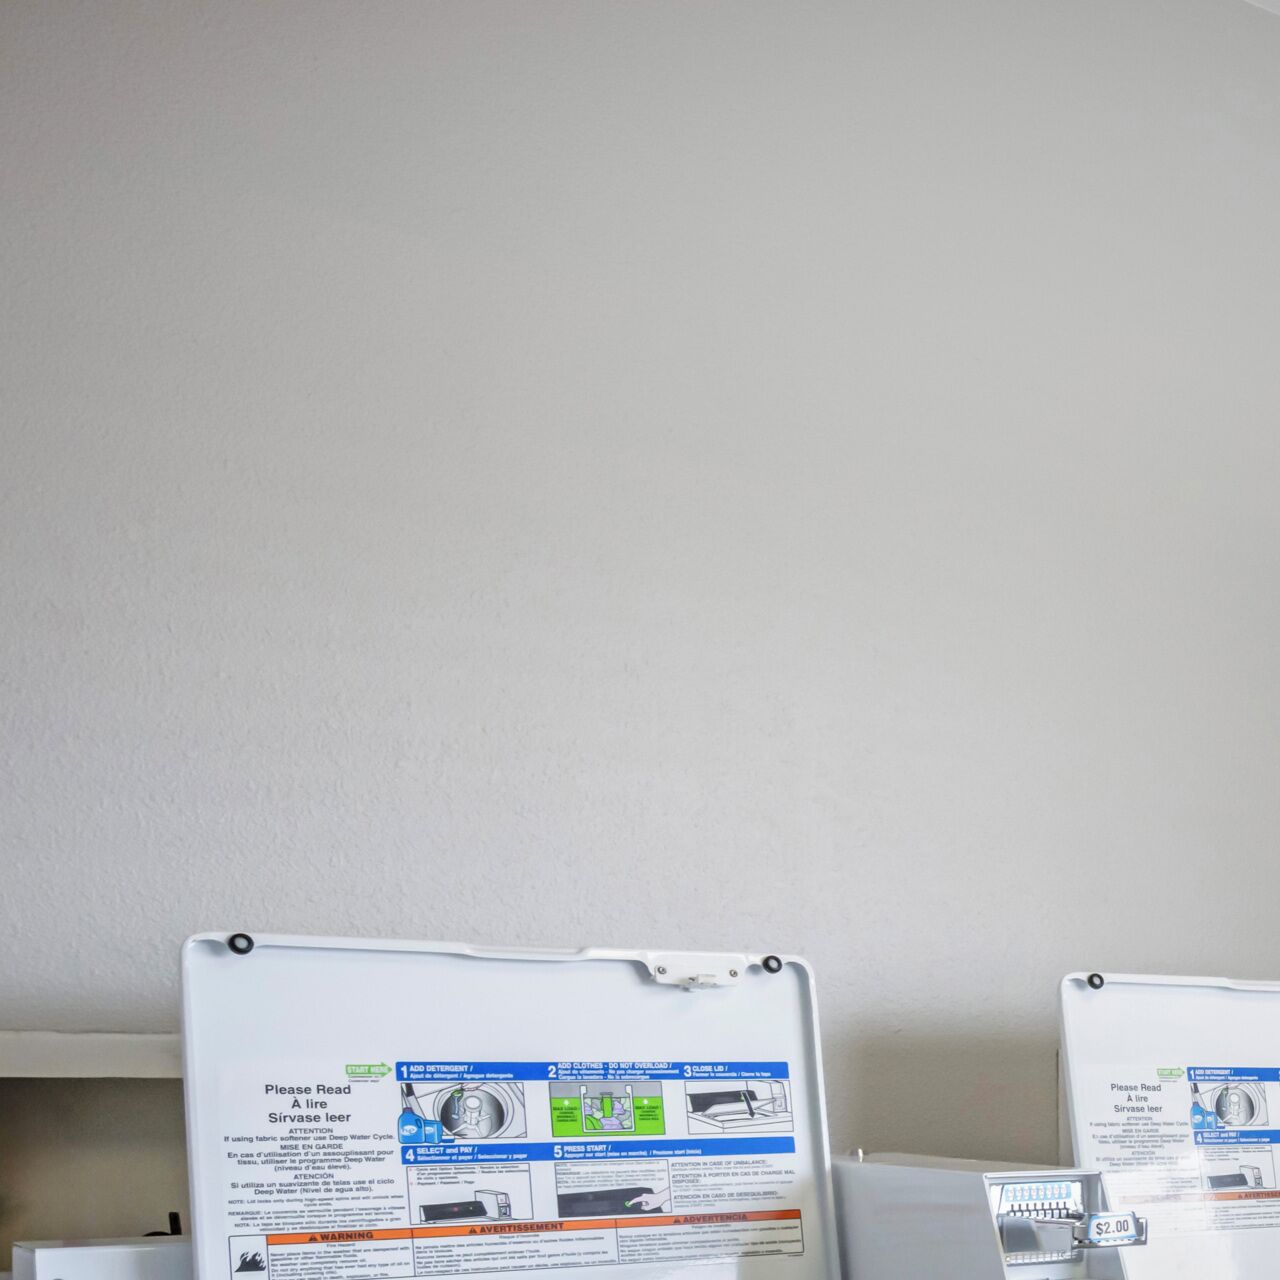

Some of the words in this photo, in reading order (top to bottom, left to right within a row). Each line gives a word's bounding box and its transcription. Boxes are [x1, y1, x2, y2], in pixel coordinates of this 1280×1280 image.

[401, 1066, 407, 1077] 1
[548, 1066, 556, 1078] 2
[684, 1066, 691, 1077] 3
[265, 1084, 311, 1095] Please
[317, 1084, 351, 1094] Read
[292, 1096, 301, 1109] À
[306, 1099, 327, 1109] lire
[269, 1112, 321, 1123] Sírvase
[326, 1112, 351, 1122] leer
[1197, 1133, 1202, 1143] 4
[406, 1150, 414, 1161] 4
[554, 1146, 562, 1157] 5
[683, 1214, 748, 1223] ADVERTENCIA
[480, 1223, 564, 1233] AVERTISSEMENT
[1096, 1220, 1129, 1236] $2.00
[320, 1232, 374, 1240] WARNING
